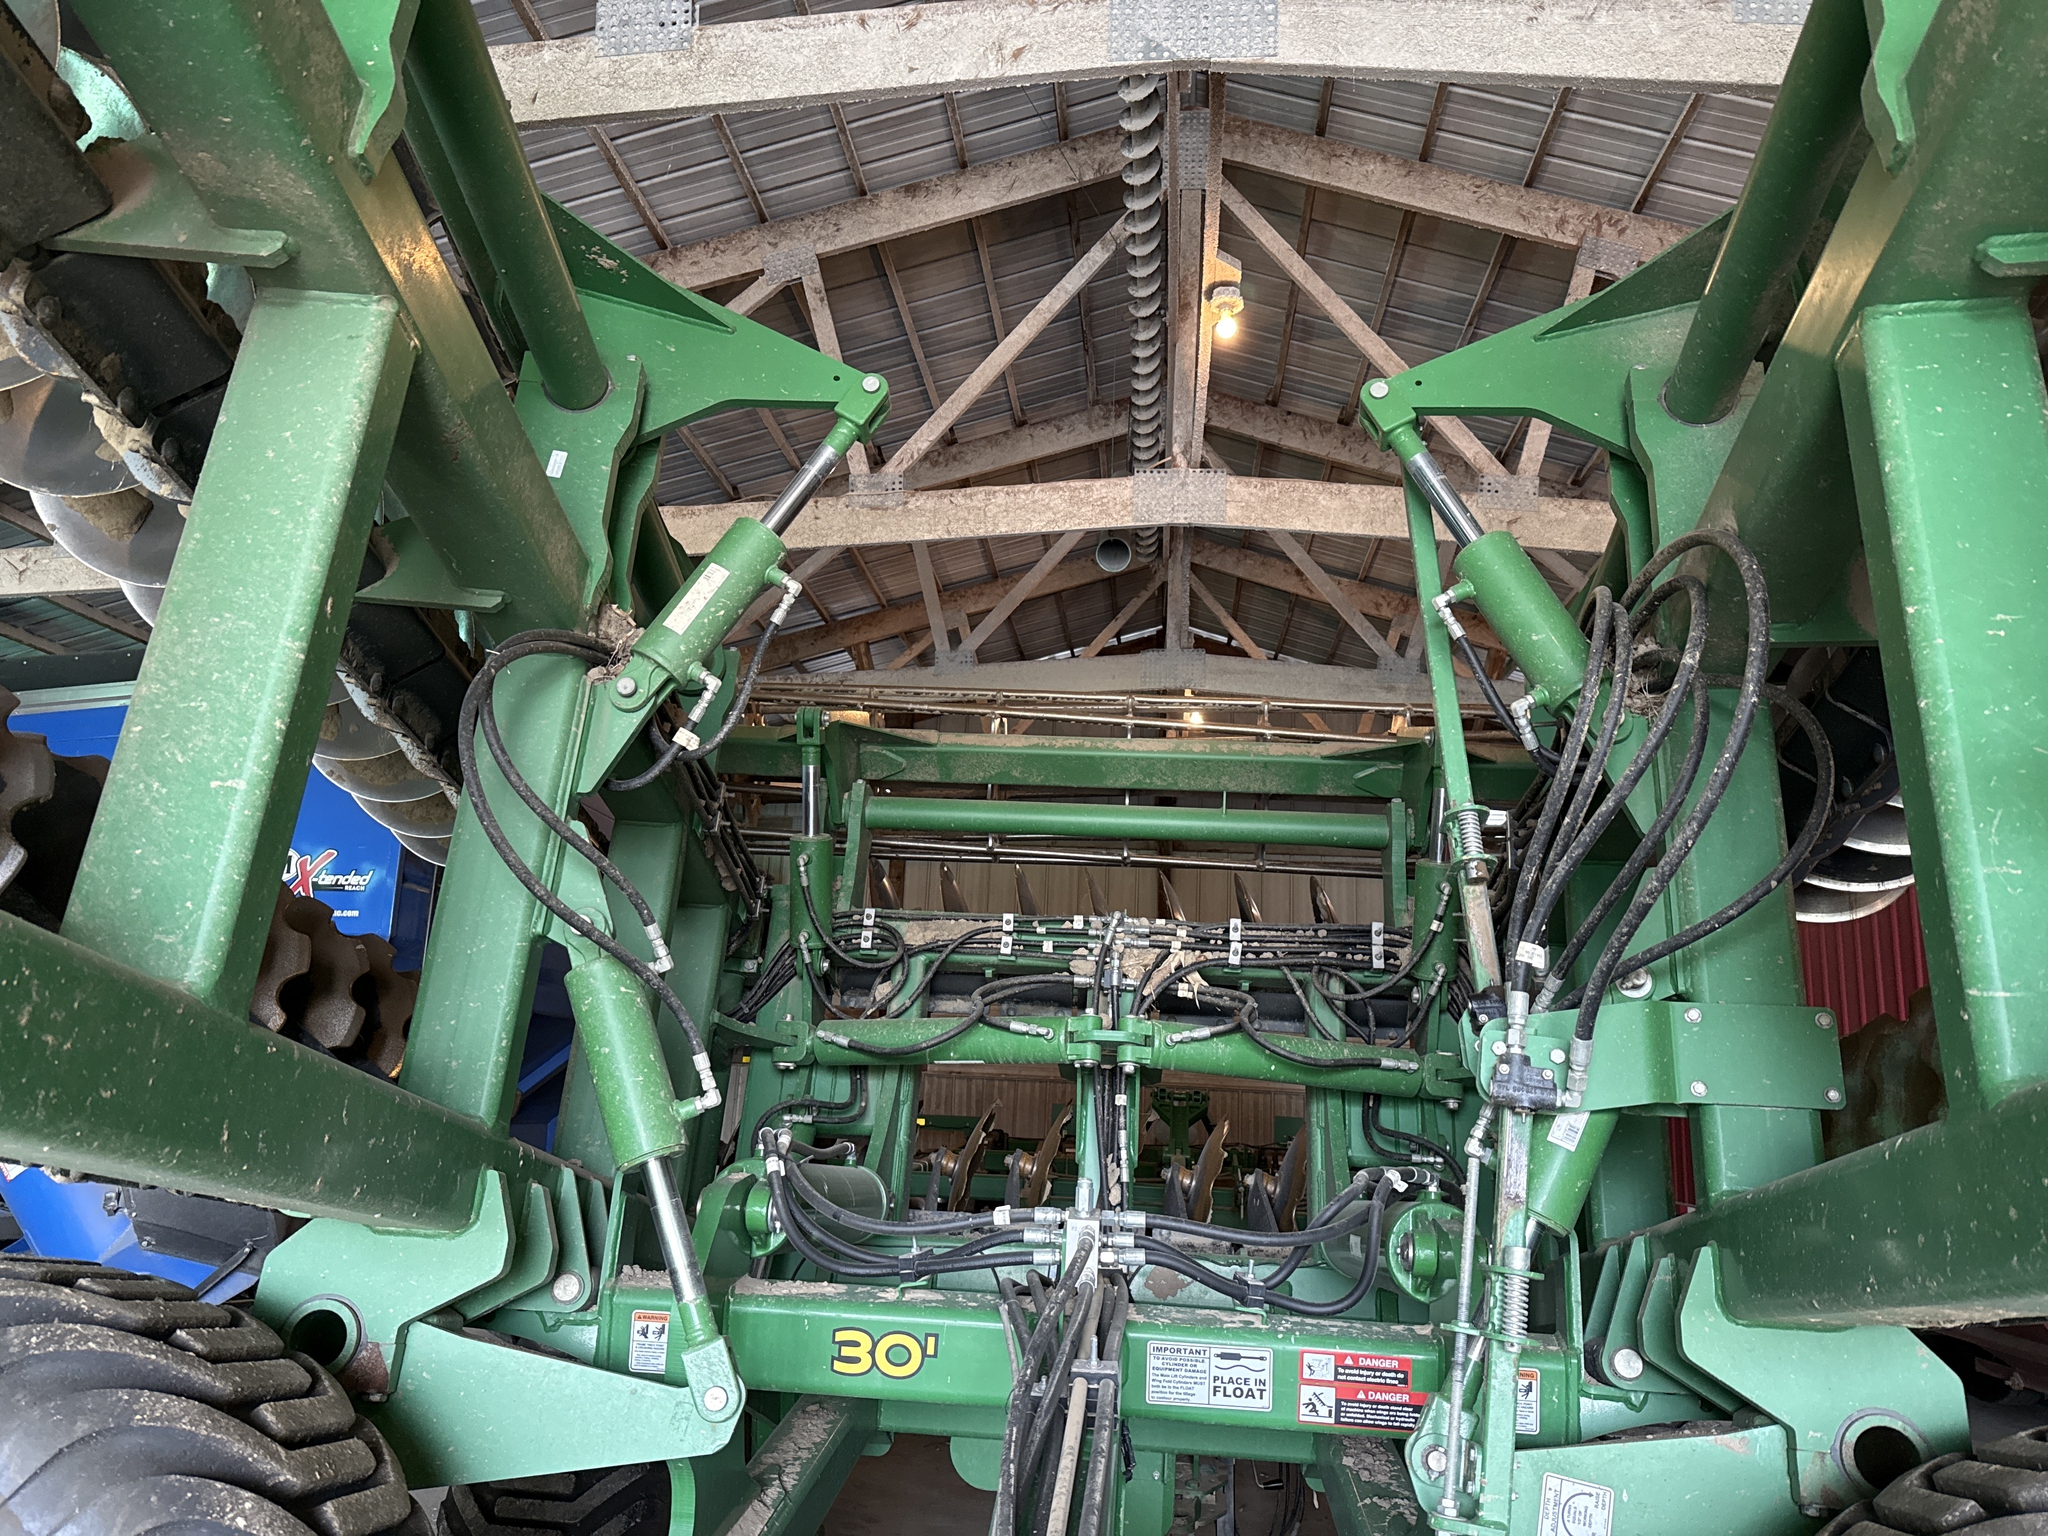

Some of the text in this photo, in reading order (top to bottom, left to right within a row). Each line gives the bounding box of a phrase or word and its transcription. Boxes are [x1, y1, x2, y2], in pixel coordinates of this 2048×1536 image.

[831, 1327, 939, 1379] 30'
[1153, 1346, 1207, 1356] IMPORTANT
[1359, 1358, 1398, 1368] DANGER
[1213, 1376, 1266, 1386] PLACE IN
[1213, 1386, 1266, 1400] FLOAT
[1368, 1390, 1409, 1402] DANGER
[1550, 1489, 1560, 1532] ADJUSTMENT
